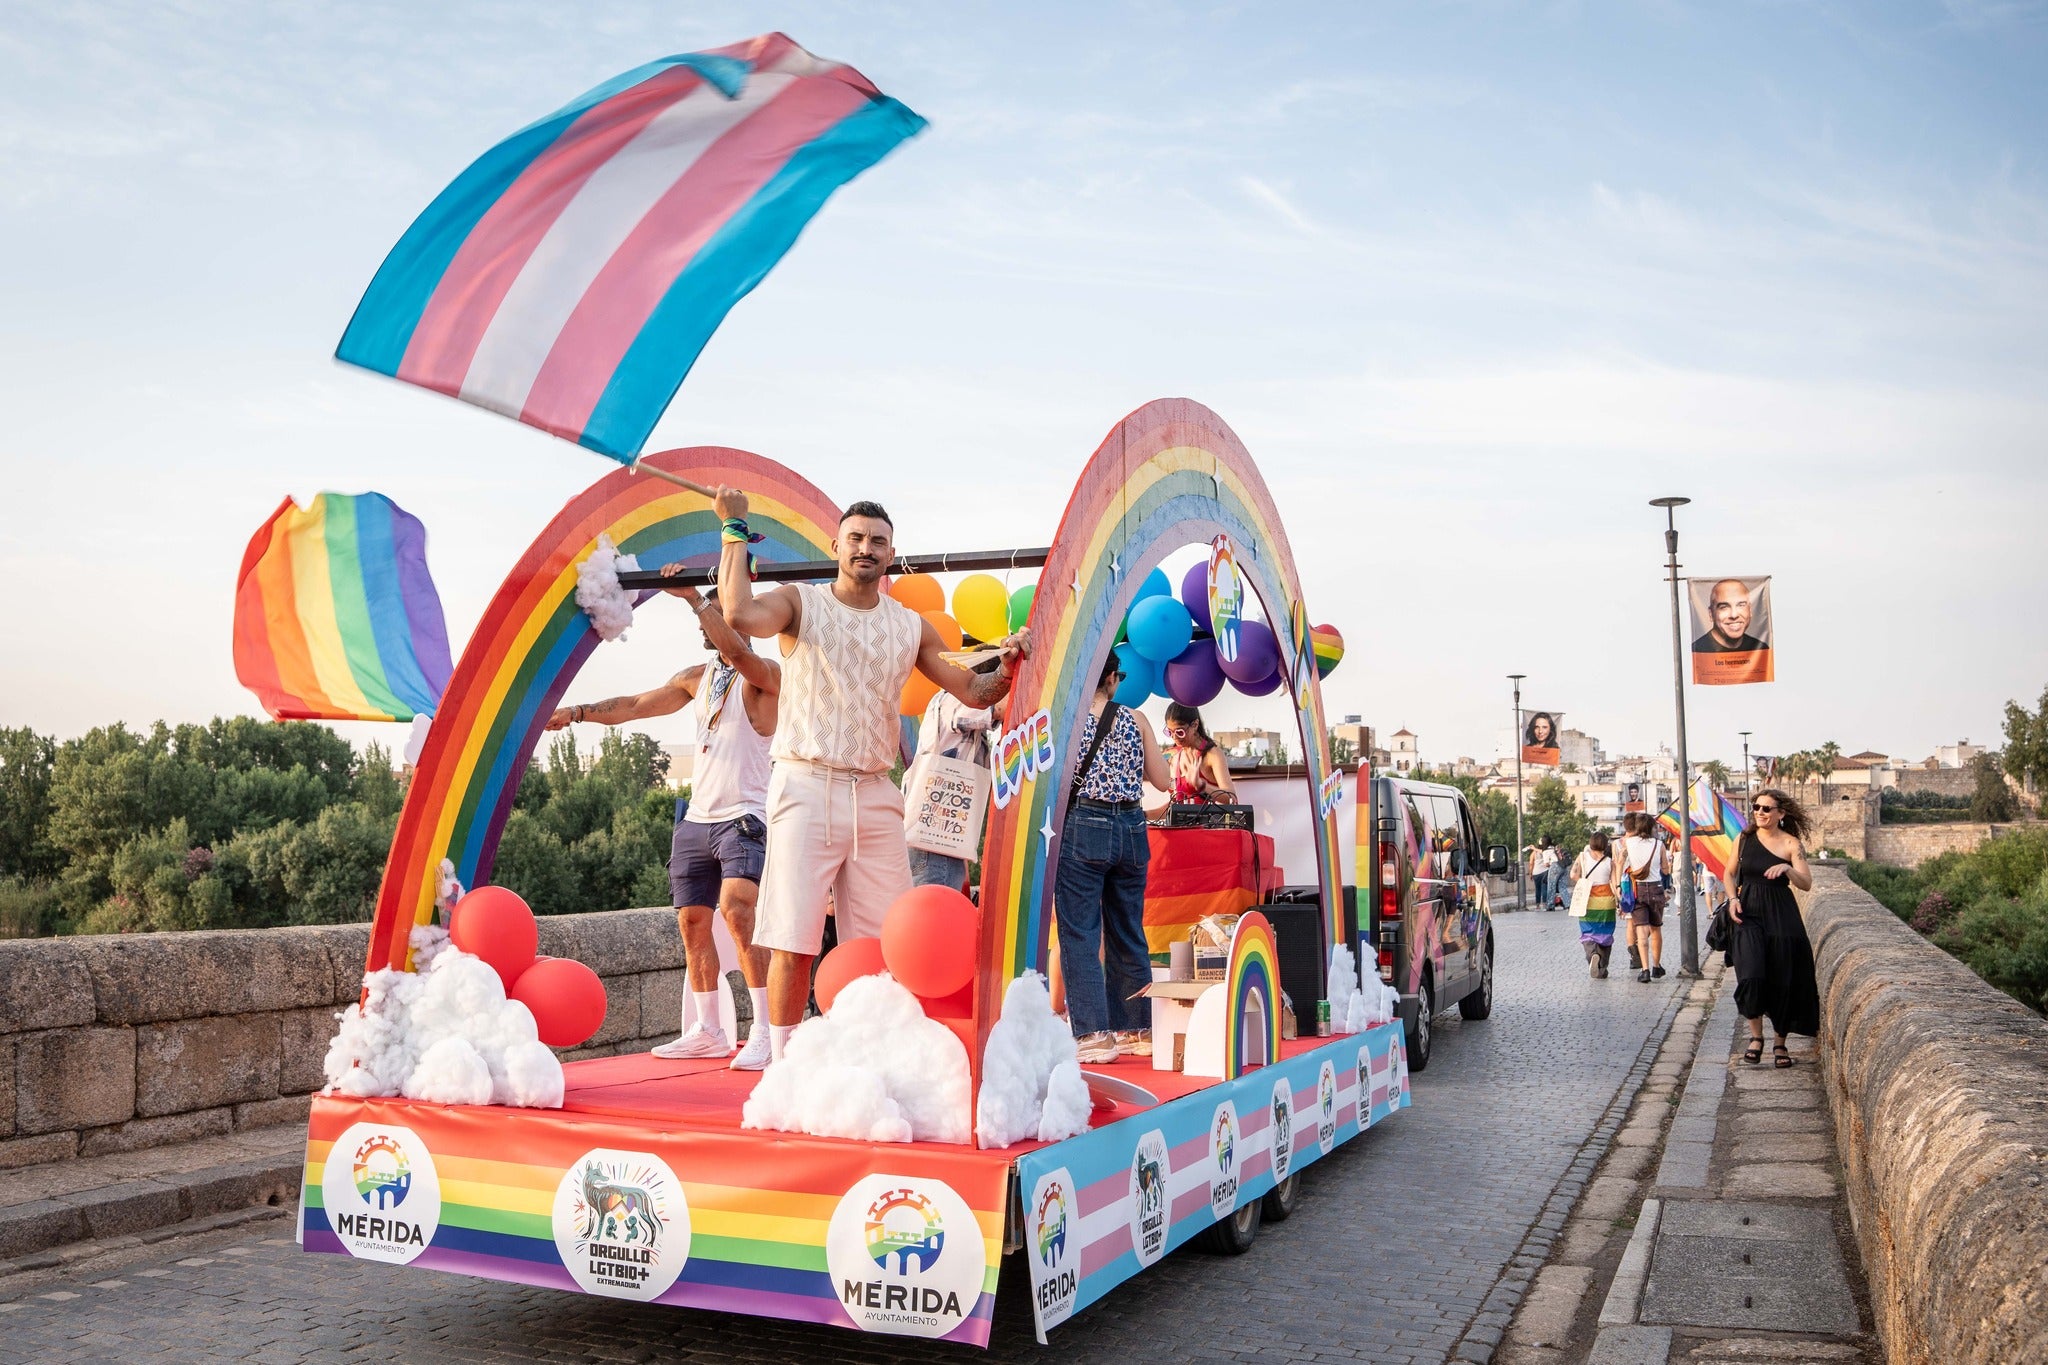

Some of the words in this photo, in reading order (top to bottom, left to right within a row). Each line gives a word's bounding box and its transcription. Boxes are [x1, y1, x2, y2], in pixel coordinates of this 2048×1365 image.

[993, 713, 1052, 802] LOVE
[1212, 1176, 1237, 1206] MÉRIDA
[337, 1212, 424, 1246] MÉRIDA
[355, 1240, 405, 1254] AYUNTAMIENTO
[590, 1243, 650, 1264] ORGULLO
[589, 1260, 650, 1281] LGTBIQ+
[597, 1277, 641, 1290] EXTREMADURA
[844, 1279, 962, 1318] MÉRIDA
[864, 1312, 938, 1326] AYUNTAMIENTO
